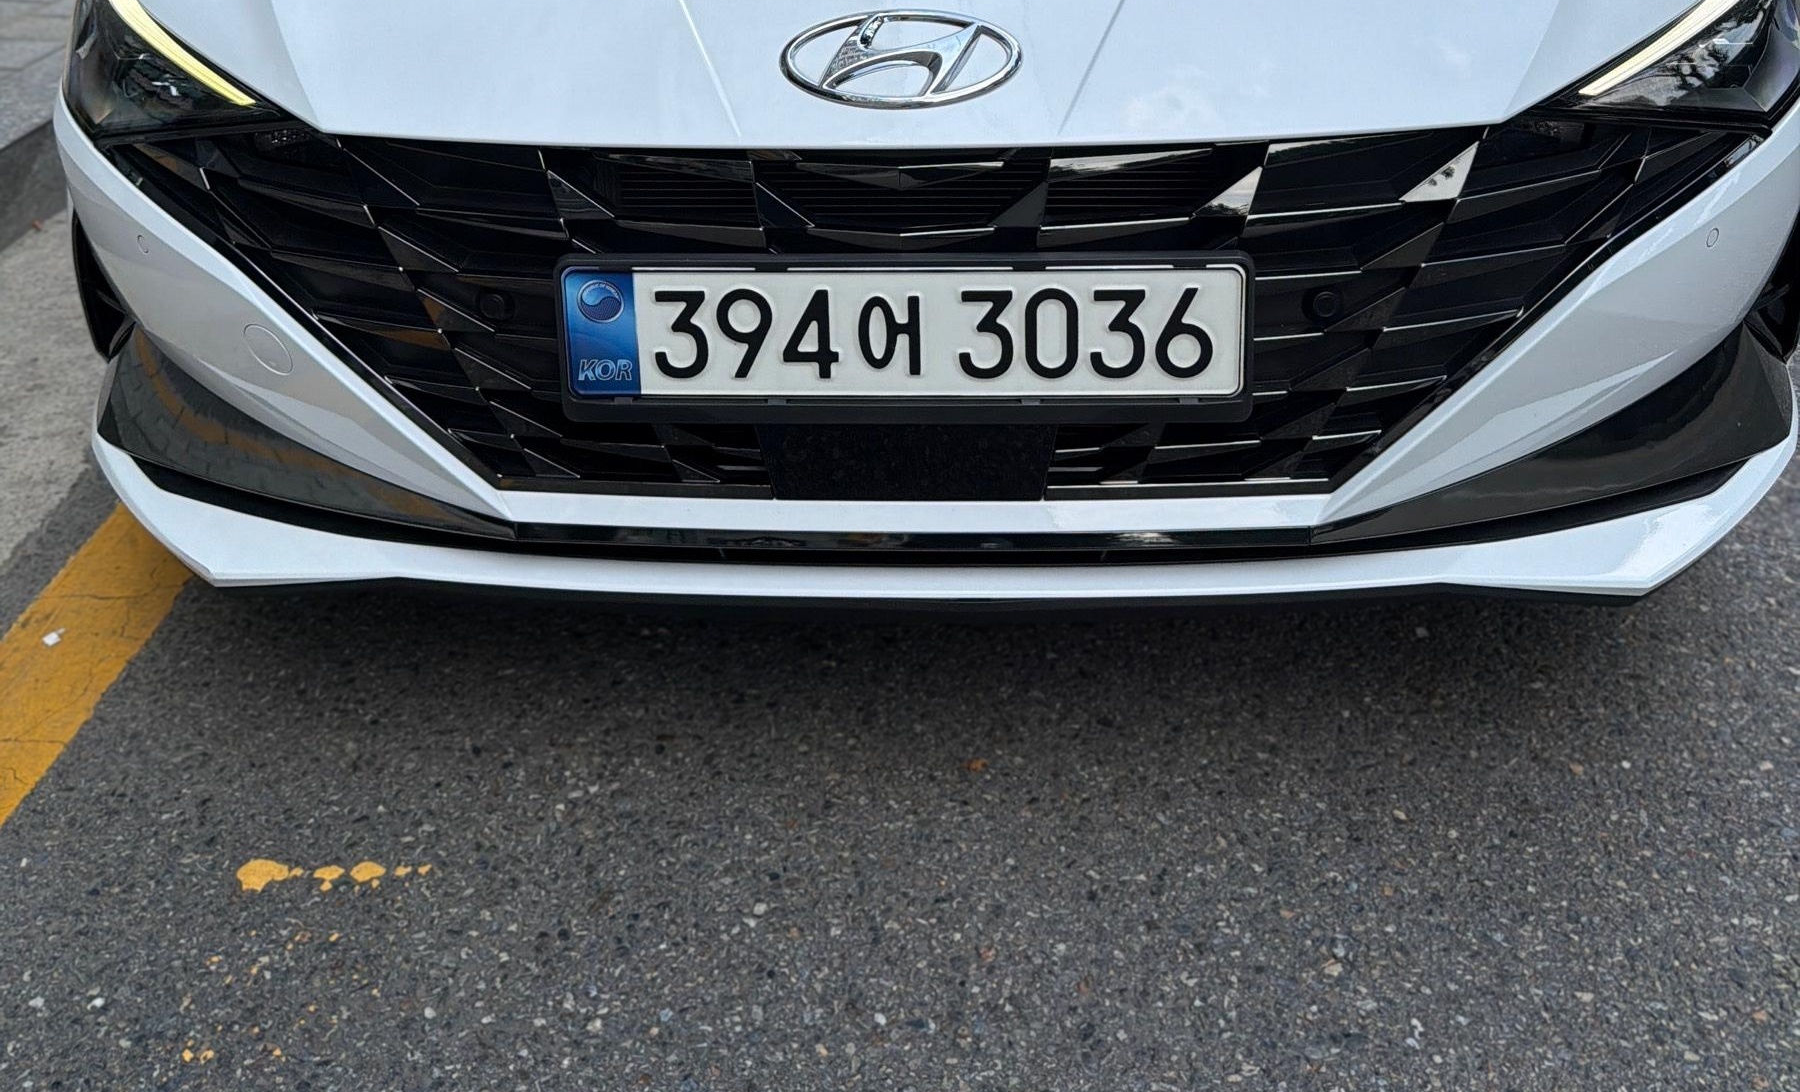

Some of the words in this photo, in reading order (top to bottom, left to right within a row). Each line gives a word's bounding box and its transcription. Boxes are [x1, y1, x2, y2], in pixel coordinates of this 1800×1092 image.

[654, 288, 922, 380] 394어
[958, 287, 1214, 380] 3036
[578, 359, 633, 381] KOR
